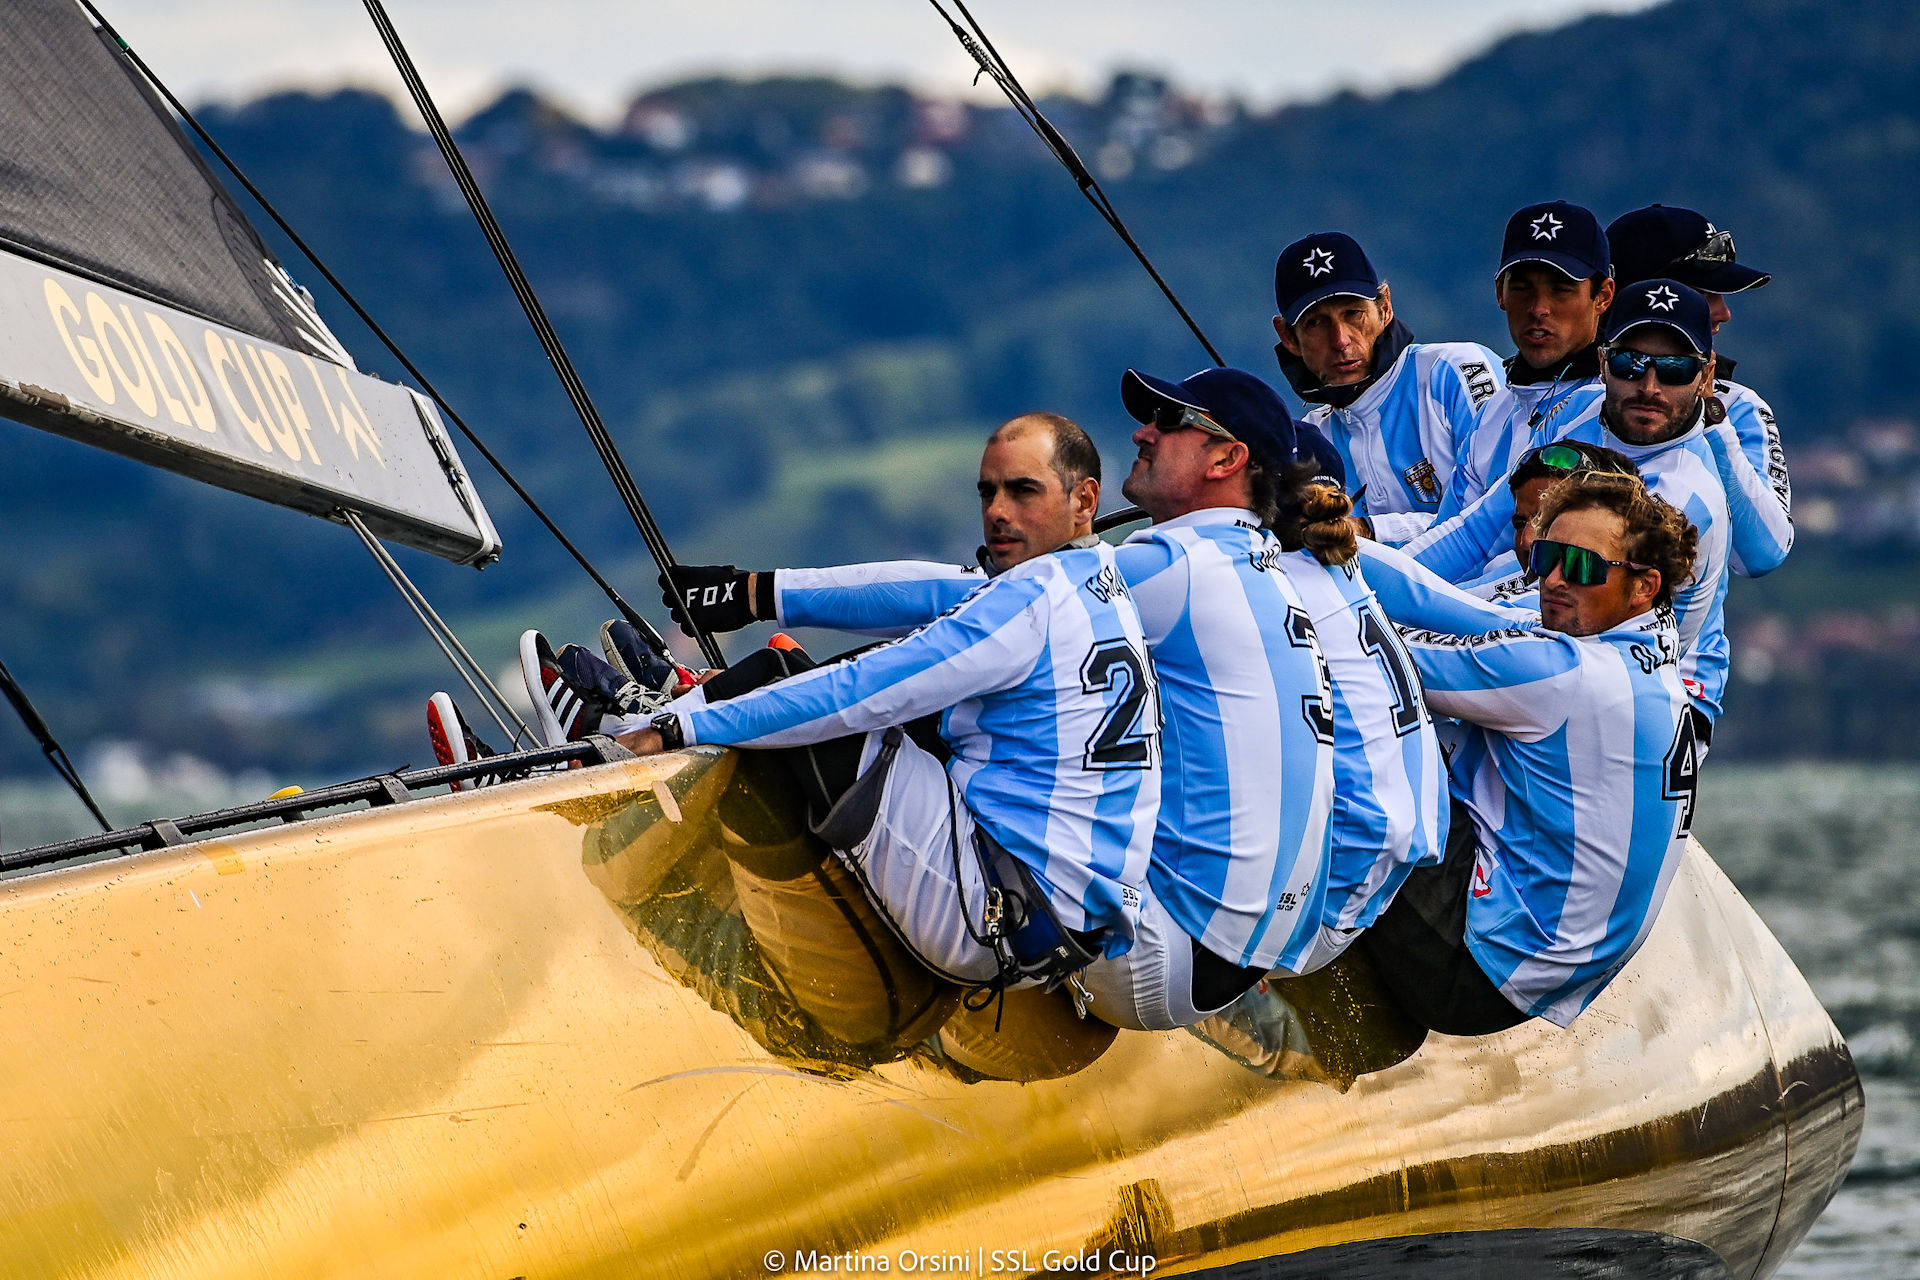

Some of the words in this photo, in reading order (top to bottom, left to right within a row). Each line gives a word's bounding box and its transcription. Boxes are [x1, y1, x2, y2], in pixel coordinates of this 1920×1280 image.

[44, 278, 217, 434] GOLD
[204, 329, 322, 466] CUP
[686, 581, 737, 609] FOX
[1661, 703, 1698, 839] 4
[1122, 888, 1139, 901] SSL
[1279, 892, 1297, 905] SSL
